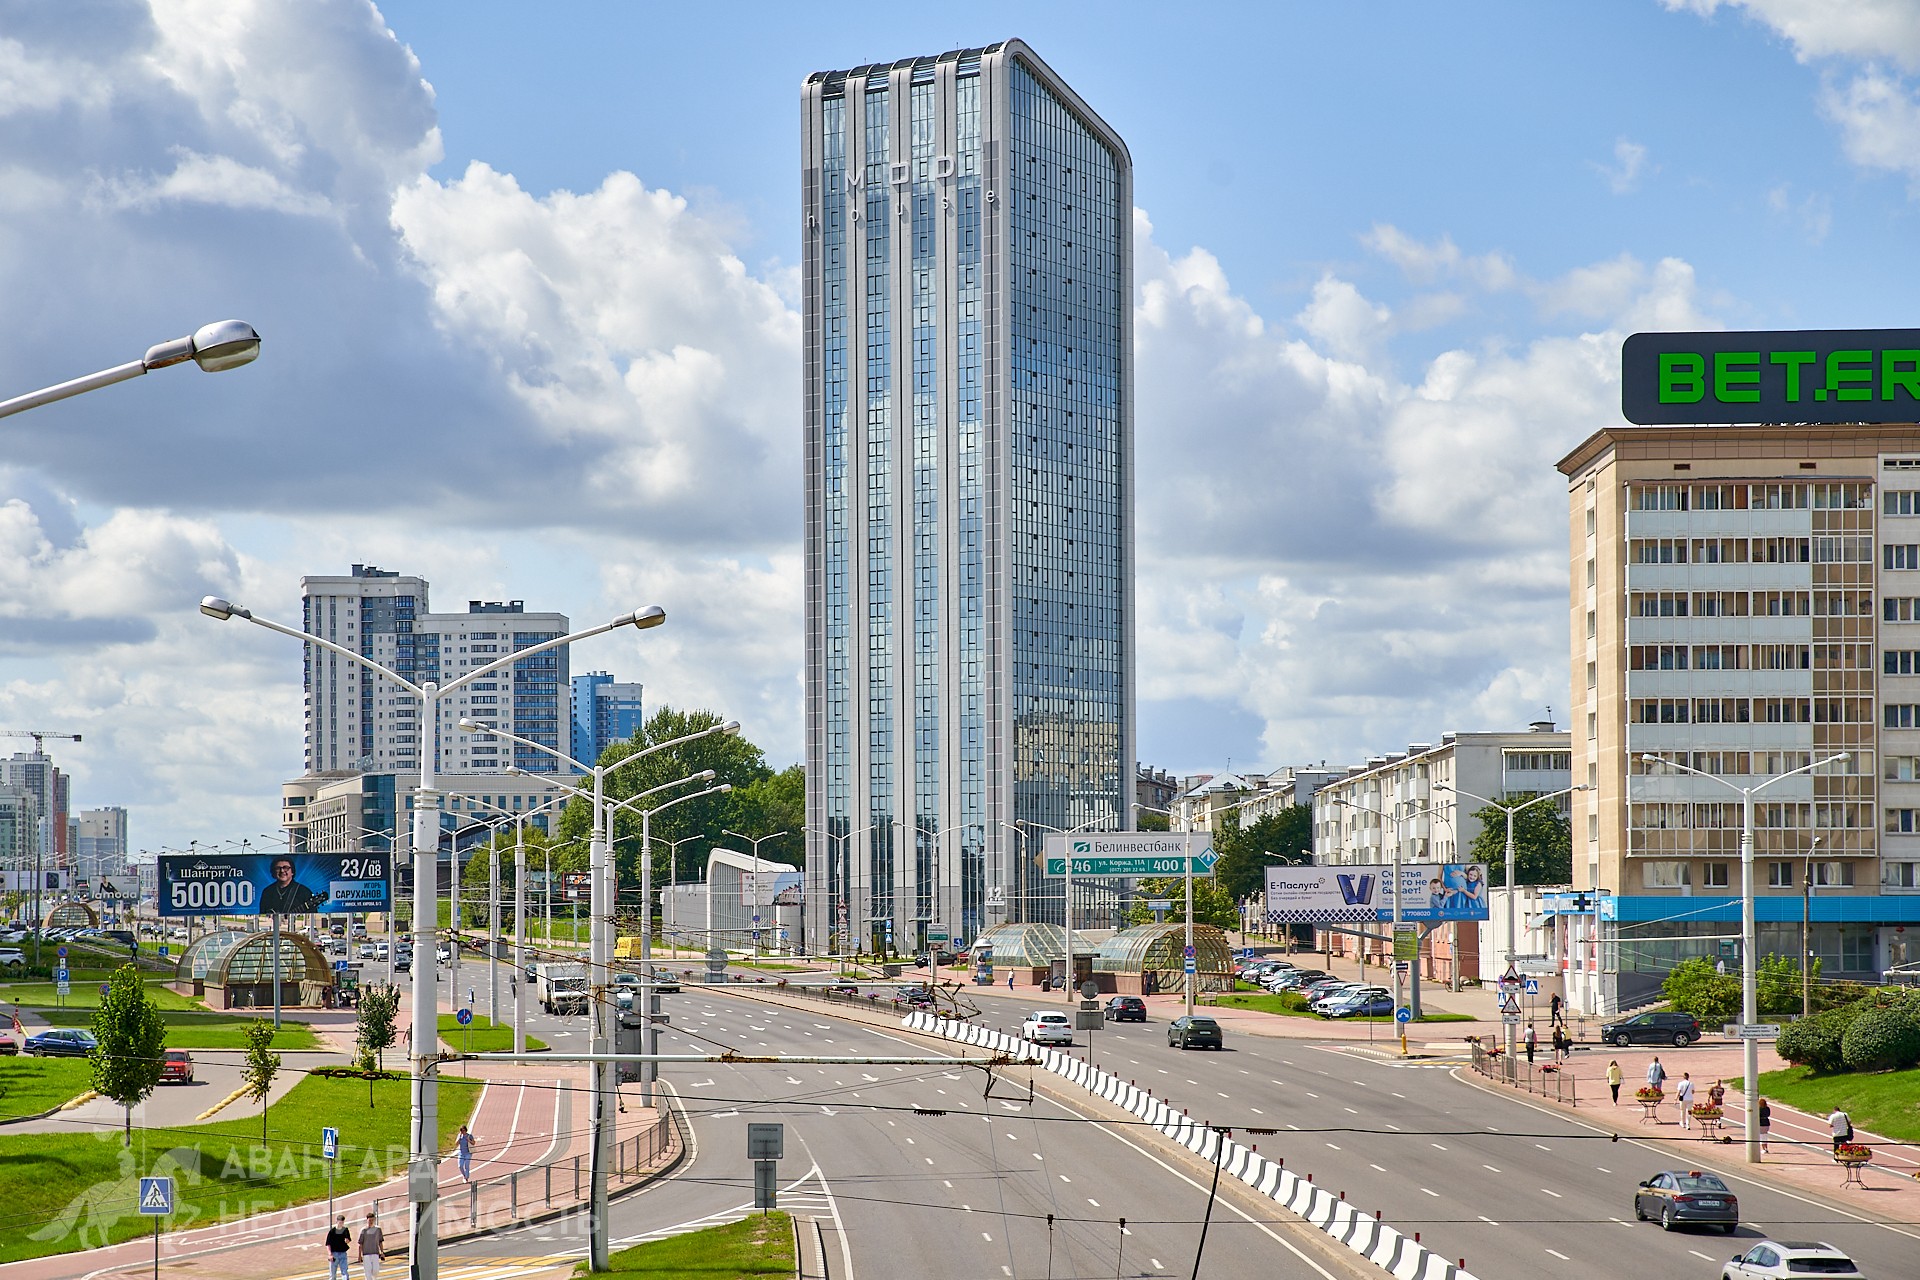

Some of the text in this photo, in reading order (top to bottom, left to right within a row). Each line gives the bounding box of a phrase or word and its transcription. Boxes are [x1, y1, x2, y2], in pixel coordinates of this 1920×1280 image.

[845, 156, 955, 192] MOD
[806, 188, 995, 228] house
[1095, 841, 1181, 853] Белинвестбанк
[1071, 860, 1091, 872] 46
[1153, 860, 1178, 871] 400
[180, 868, 225, 880] Шангри
[228, 868, 244, 877] Ла
[1381, 870, 1422, 878] Счстья
[1270, 881, 1319, 891] Е-Паслуга
[91, 890, 137, 899] lamoda
[171, 880, 253, 908] 50000
[335, 890, 381, 899] САРУХАНОВ
